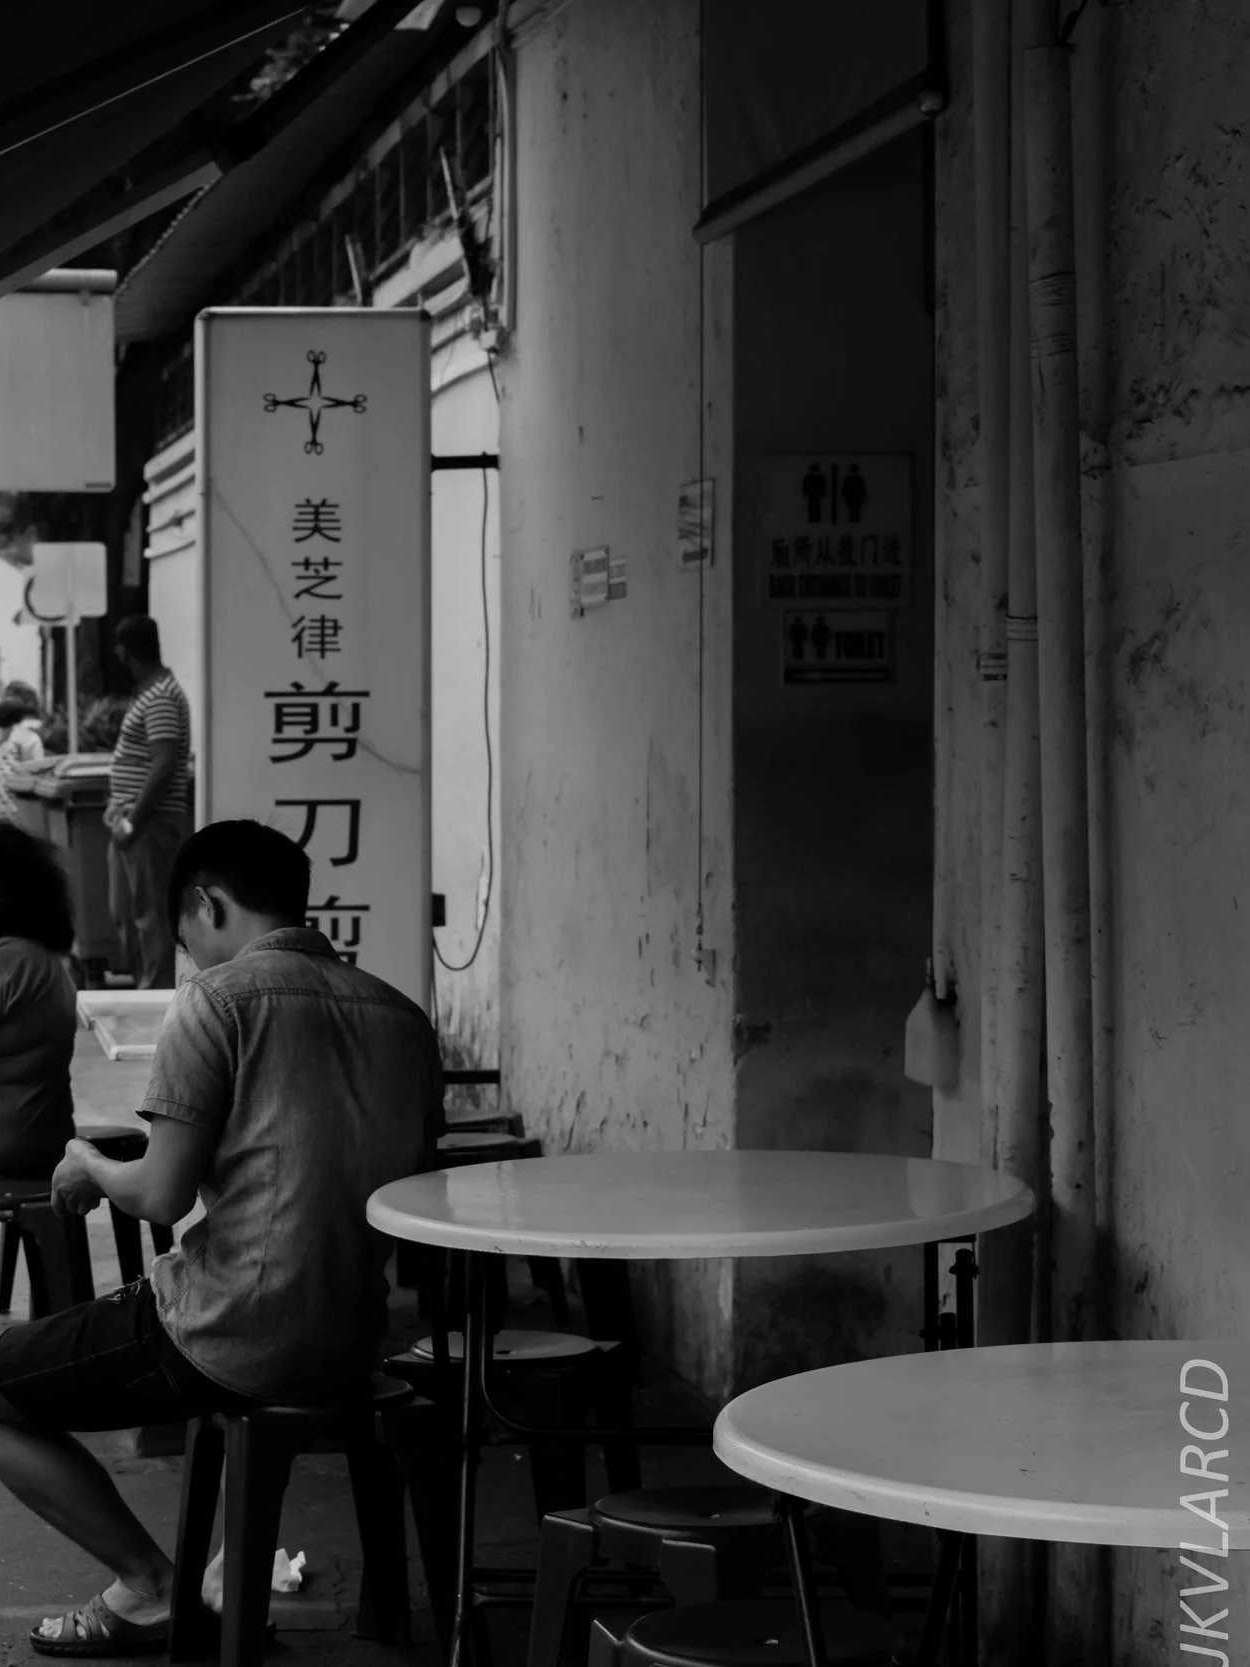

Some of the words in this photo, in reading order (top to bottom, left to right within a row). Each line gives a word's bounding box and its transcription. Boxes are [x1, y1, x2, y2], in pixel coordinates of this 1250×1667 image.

[290, 497, 343, 660] 美芝律
[833, 631, 885, 659] TOILET
